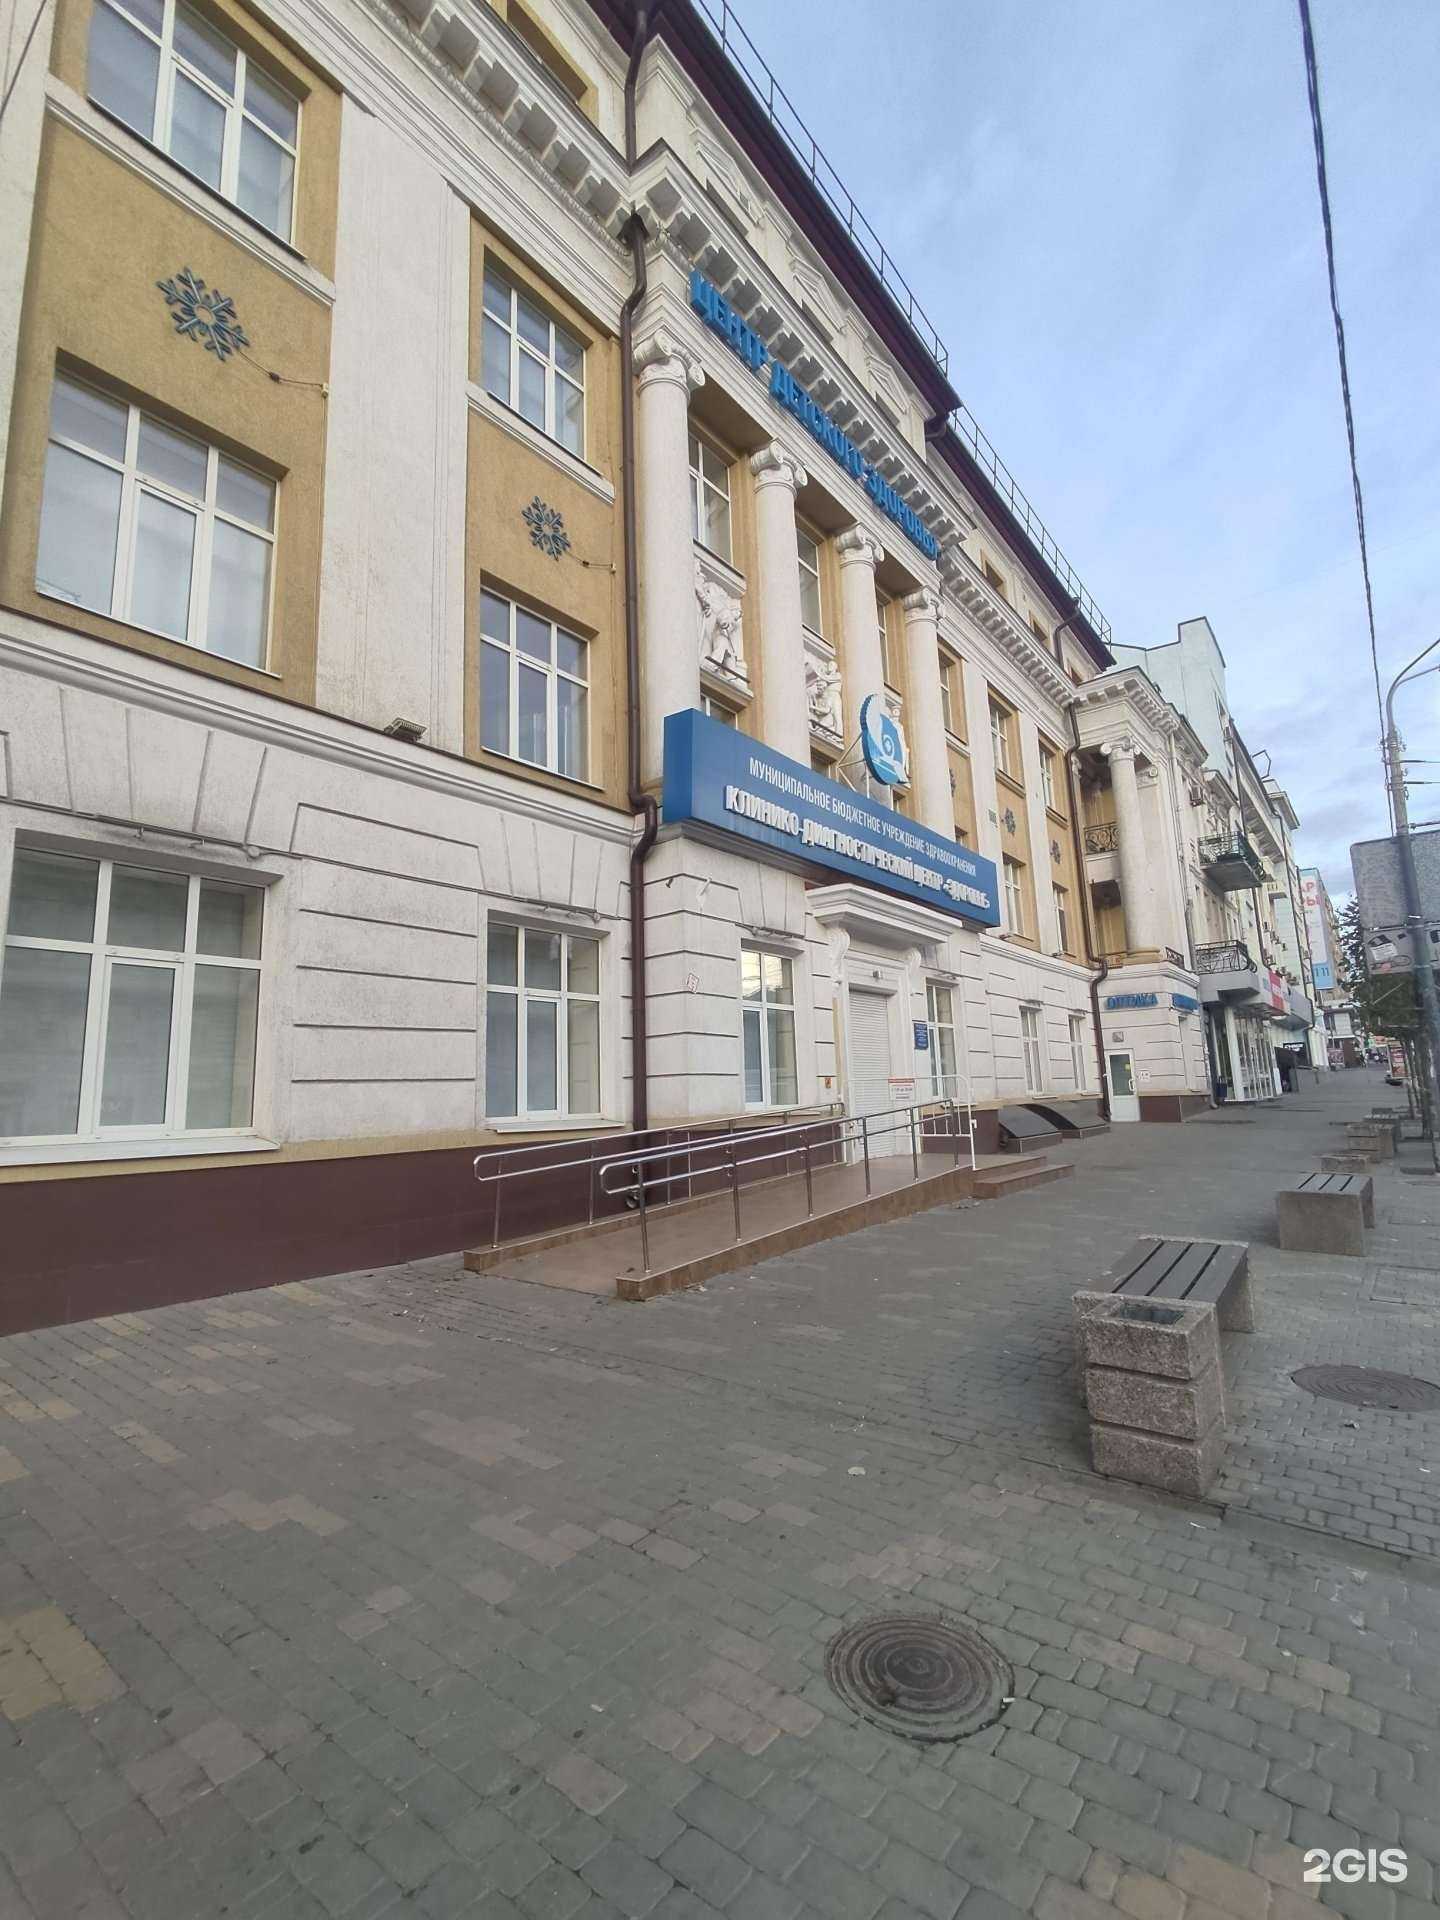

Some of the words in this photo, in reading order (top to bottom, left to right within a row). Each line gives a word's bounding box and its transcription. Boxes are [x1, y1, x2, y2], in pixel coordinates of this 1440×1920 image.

[725, 785, 914, 881] КЛИНИКО-ДИАГНОСТИЧЕСКИЙ
[913, 863, 944, 892] ЦЕНТР
[749, 756, 831, 811] МУНИЦИПАЛЬНОЕ
[832, 798, 881, 834] БЮДЖЕТНОЕ
[881, 820, 925, 855] УЧРЕЖДЕНИЕ
[923, 841, 977, 878] ЗДРАВООХРАНЕНИЯ
